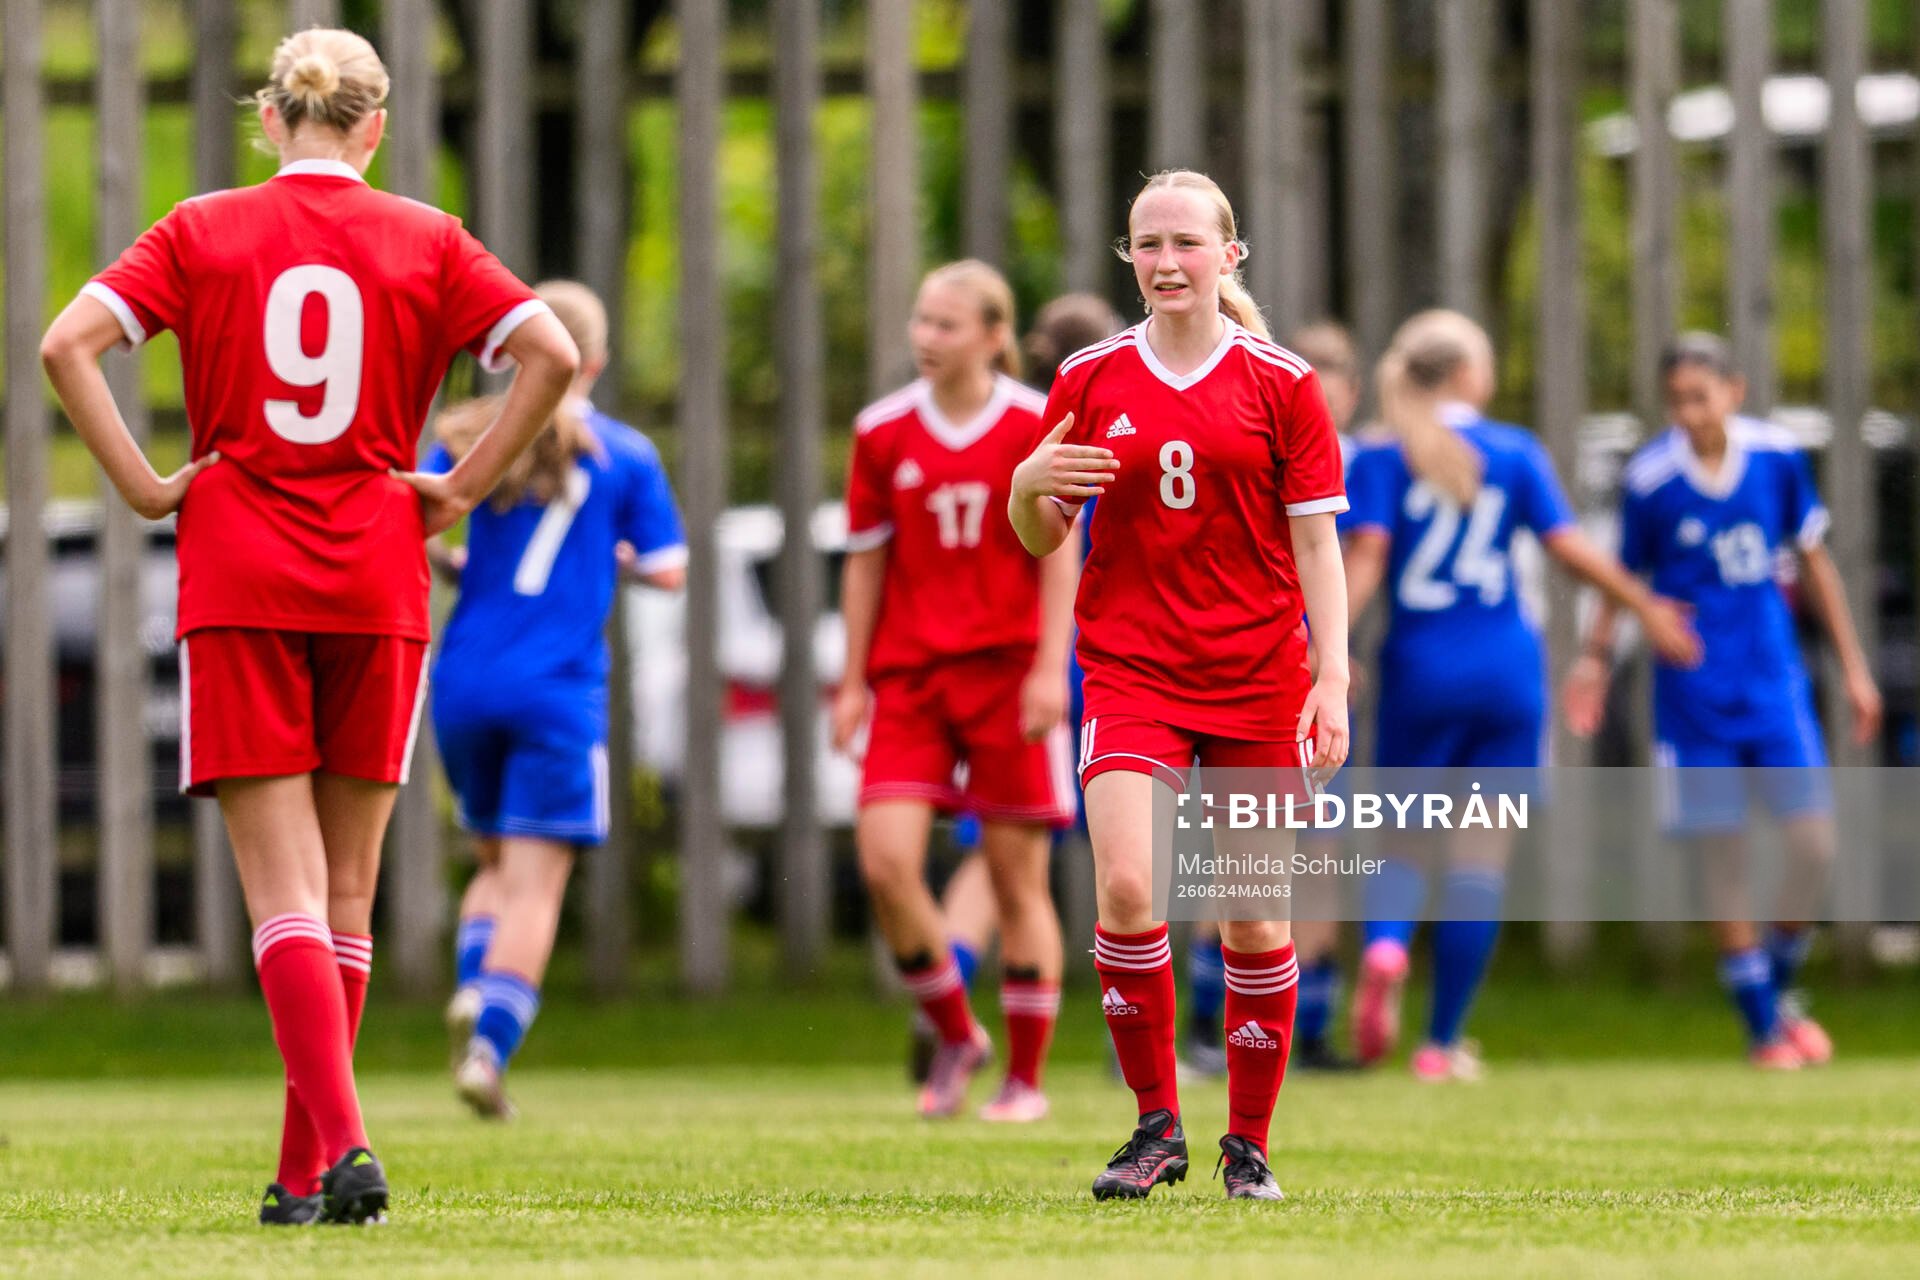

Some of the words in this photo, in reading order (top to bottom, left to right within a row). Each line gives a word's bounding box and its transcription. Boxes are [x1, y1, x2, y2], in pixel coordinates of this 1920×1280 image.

[263, 264, 364, 445] 9
[1106, 427, 1137, 439] adidas
[1159, 440, 1196, 510] 8
[925, 482, 992, 549] 17
[1399, 480, 1507, 611] 24
[1228, 1033, 1278, 1050] adidas
